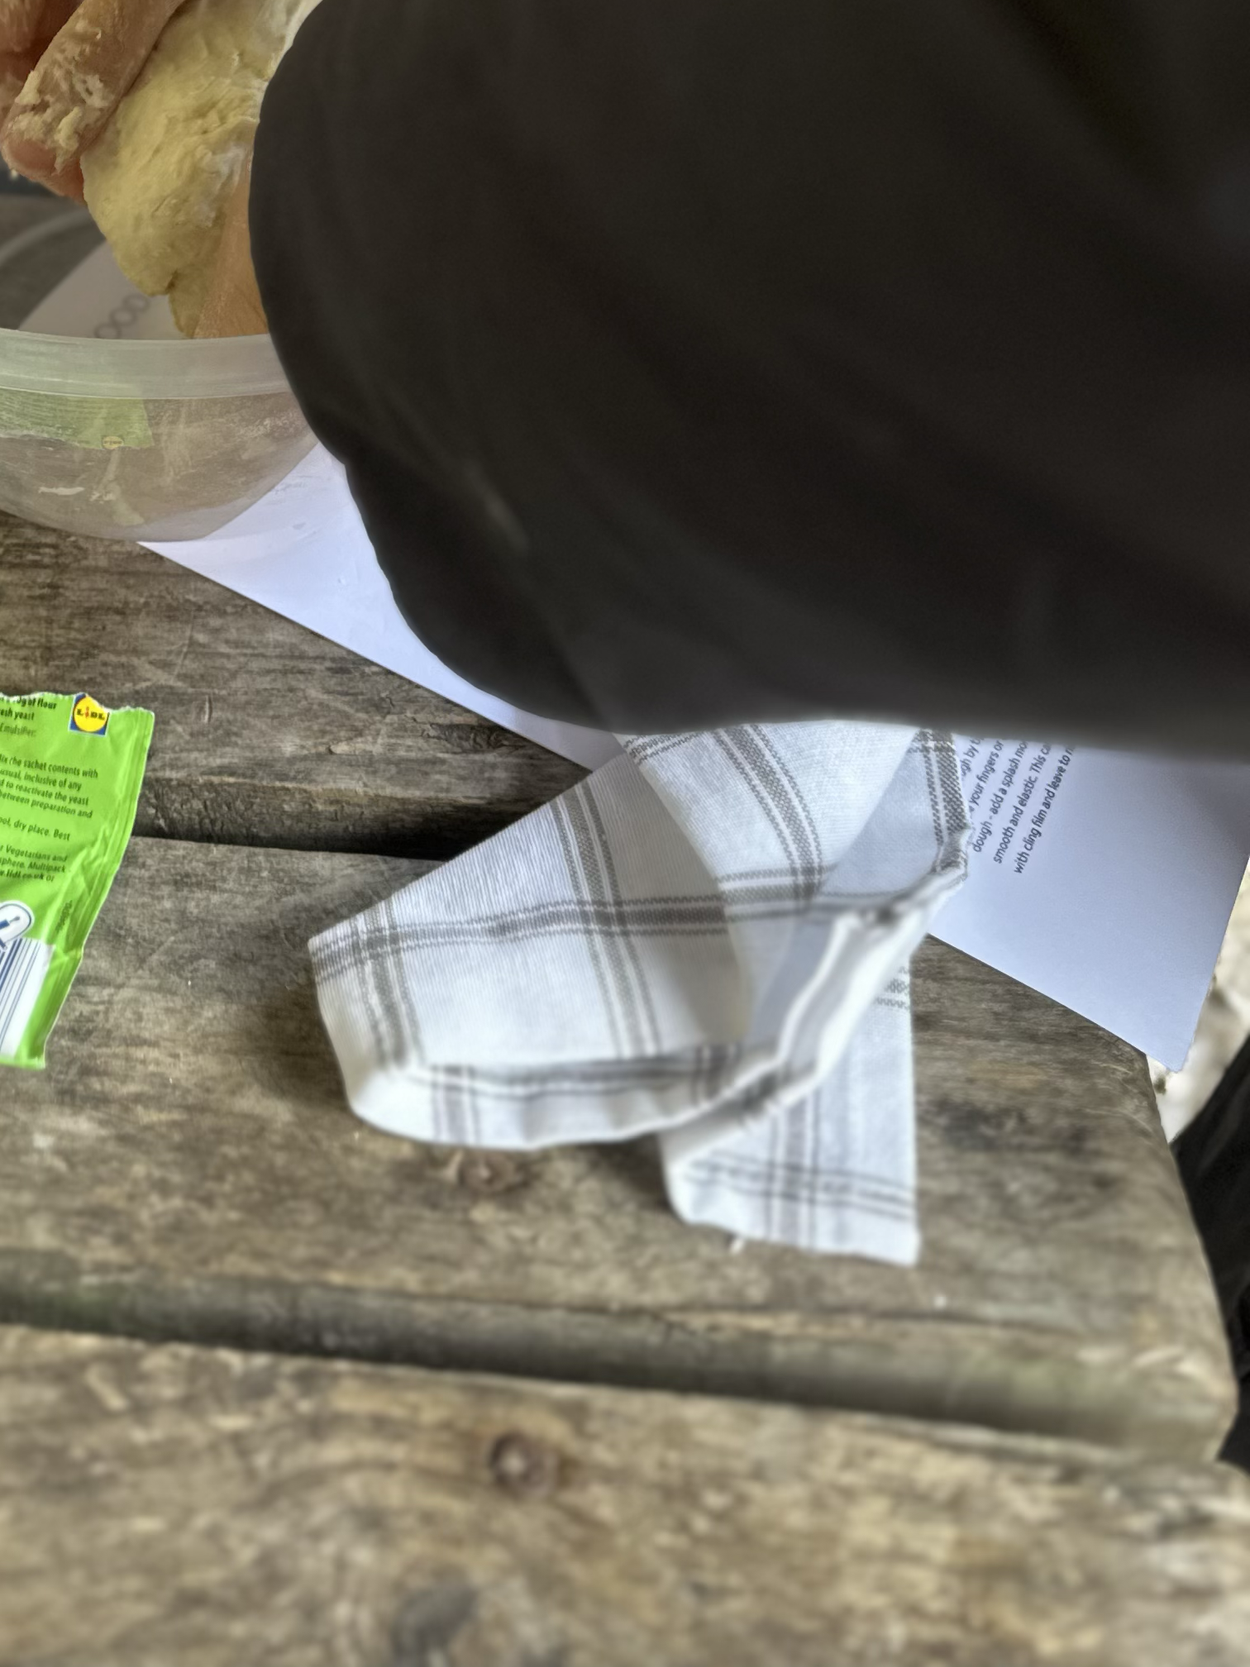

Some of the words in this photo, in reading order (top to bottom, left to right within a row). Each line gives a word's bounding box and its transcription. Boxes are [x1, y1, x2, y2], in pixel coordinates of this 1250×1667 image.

[37, 698, 57, 709] flour
[964, 746, 979, 758] by
[1058, 755, 1070, 766] to
[9, 757, 22, 766] the
[24, 758, 47, 771] sachet
[48, 764, 80, 776] contents
[82, 769, 98, 778] with
[976, 752, 999, 783] fingers
[1047, 766, 1066, 790] leave
[24, 772, 57, 786] inclusive
[58, 778, 67, 788] of
[68, 781, 82, 791] any
[6, 780, 14, 788] to
[15, 783, 53, 798] reactivate
[54, 792, 67, 801] the
[68, 795, 89, 805] yeast
[970, 782, 984, 806] your
[1042, 788, 1055, 810] and
[31, 799, 76, 815] preparation
[77, 810, 93, 818] and
[973, 821, 992, 853] dough
[990, 793, 1004, 815] add
[1002, 758, 1020, 788] splash
[994, 824, 1015, 864] smooth
[1010, 806, 1024, 827] and
[1017, 776, 1038, 806] elastic.
[1029, 755, 1046, 773] This
[1032, 809, 1047, 828] film
[14, 820, 26, 830] dry
[53, 829, 70, 841] Best
[1024, 828, 1042, 852] cling
[6, 846, 50, 861] Vegetarians
[52, 854, 67, 862] and
[1014, 850, 1029, 874] with
[28, 861, 65, 872] Multipack
[45, 874, 55, 882] or
